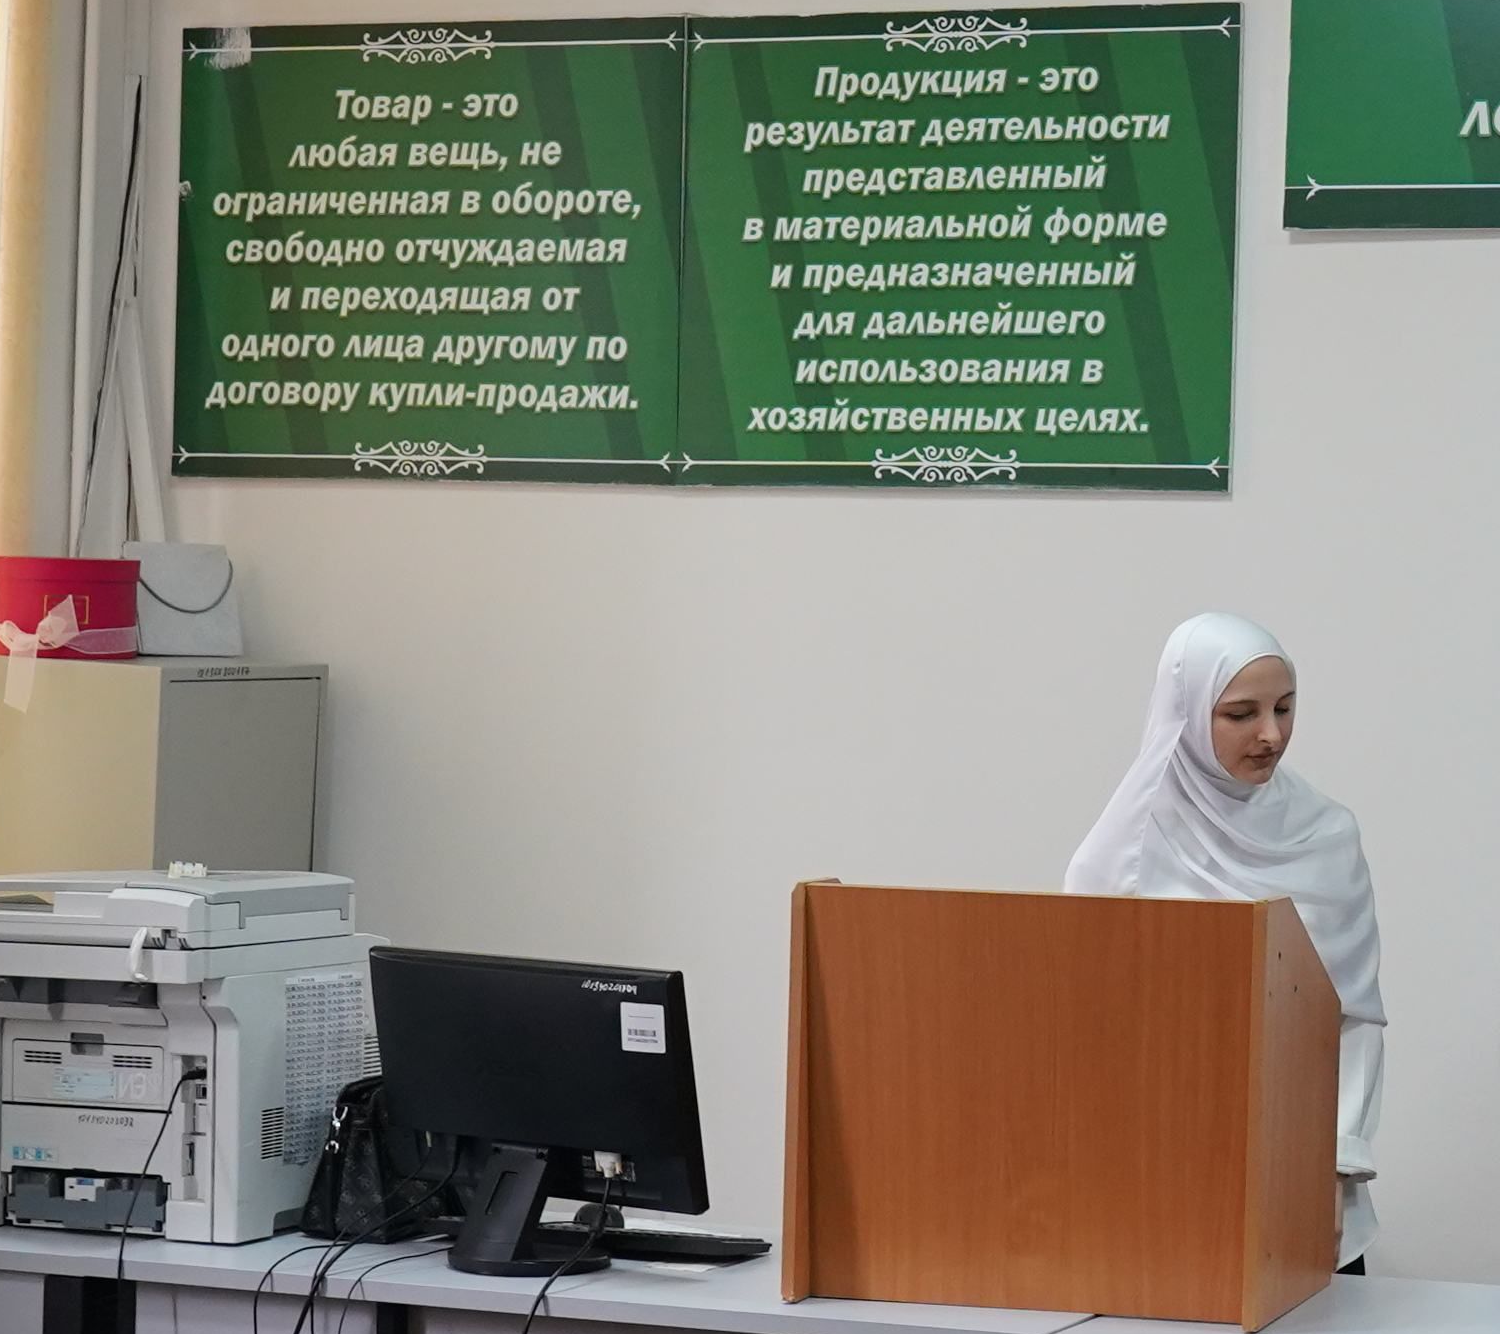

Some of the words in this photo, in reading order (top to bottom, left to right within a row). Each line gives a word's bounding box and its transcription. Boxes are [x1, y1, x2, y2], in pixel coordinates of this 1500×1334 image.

[814, 66, 1008, 103] Продукция
[1038, 66, 1099, 92] это
[335, 89, 432, 126] Товар
[462, 93, 519, 118] это
[743, 119, 916, 153] результат
[920, 114, 1171, 147] деятельности
[288, 135, 399, 167] любая
[408, 142, 508, 172] вещь,
[520, 141, 562, 166] не
[802, 155, 1107, 199] представленный
[213, 190, 451, 222] ограниченная
[460, 190, 481, 214] в
[491, 181, 641, 221] обороте,
[742, 217, 764, 241] в
[773, 204, 1033, 246] материальной
[1043, 206, 1168, 244] форме
[225, 230, 385, 267] свободно
[395, 238, 628, 269] отчуждаемая
[770, 264, 793, 288] и
[802, 252, 1136, 294] предназначенный
[270, 286, 292, 310] и
[300, 286, 532, 317] переходящая
[542, 287, 581, 311] от
[792, 311, 856, 340] для
[862, 301, 1106, 340] дальнейшего
[221, 333, 336, 362] одного
[342, 334, 425, 363] лица
[432, 335, 578, 367] другому
[585, 335, 628, 360] по
[795, 358, 1071, 383] использования
[1081, 359, 1104, 383] в
[204, 381, 361, 412] договору
[368, 382, 639, 415] купли-продажи.
[747, 398, 1026, 432] хозяйственных
[1034, 407, 1149, 436] целях.
